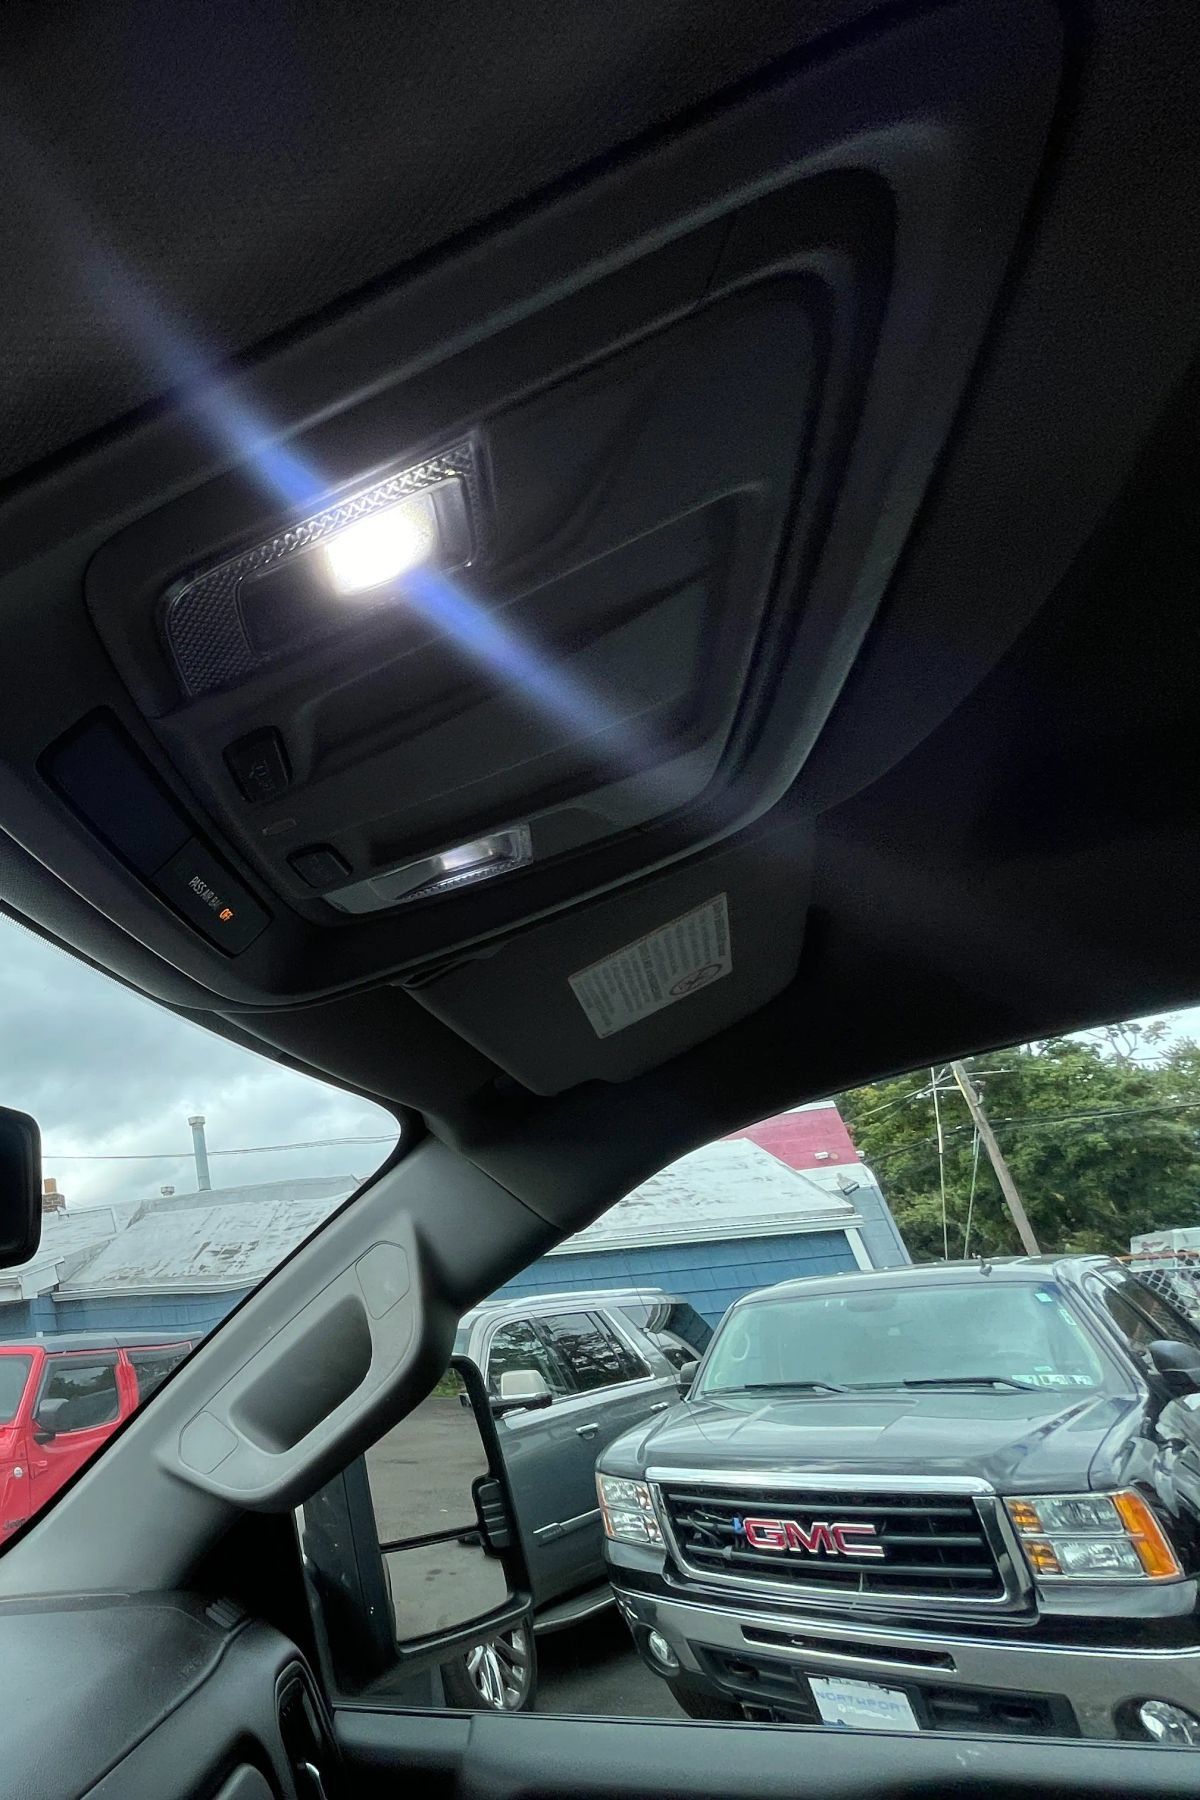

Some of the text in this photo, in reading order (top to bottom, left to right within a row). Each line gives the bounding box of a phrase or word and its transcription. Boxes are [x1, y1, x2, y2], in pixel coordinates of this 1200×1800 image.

[188, 876, 207, 895] PASS
[219, 908, 234, 921] OFF
[743, 1517, 885, 1557] GMC
